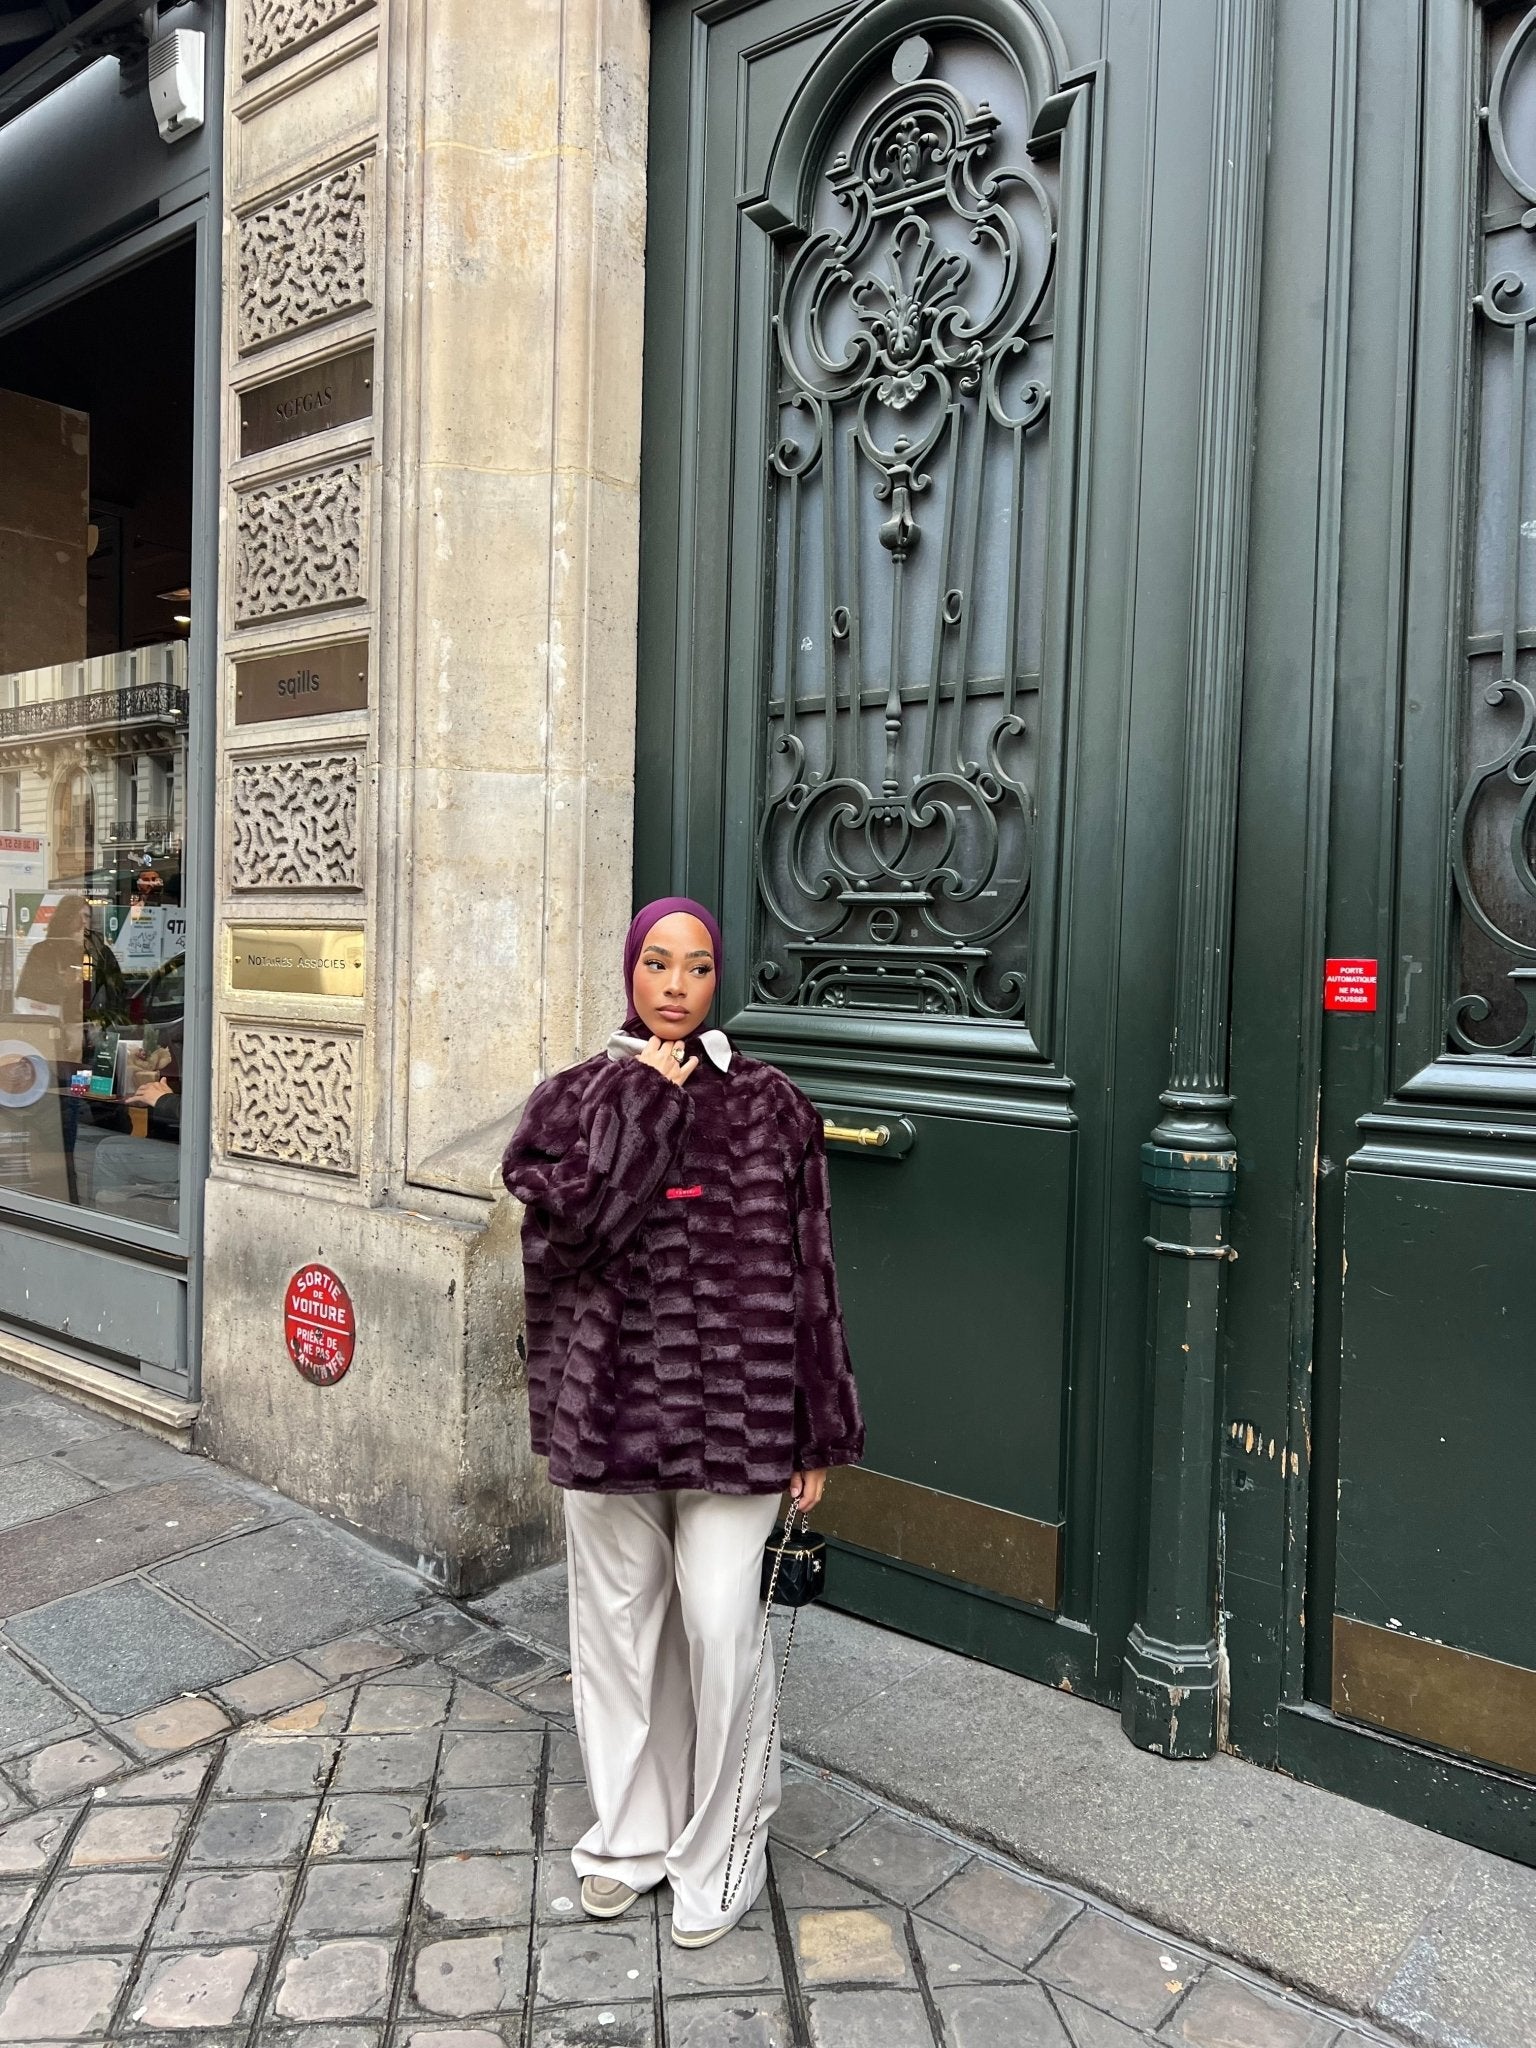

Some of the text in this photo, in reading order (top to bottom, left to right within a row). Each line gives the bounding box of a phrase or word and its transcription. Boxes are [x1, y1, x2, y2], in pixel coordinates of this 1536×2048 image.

[278, 669, 320, 700] sqills
[1340, 967, 1364, 975] PORTE
[1326, 976, 1377, 984] AUTOMATIQUE
[1349, 987, 1364, 995] PAS
[1334, 996, 1368, 1004] POUSSER
[296, 1271, 341, 1302] SORTIE
[312, 1289, 324, 1300] DE
[291, 1295, 346, 1325] VOITURE
[326, 1336, 338, 1351] DE
[303, 1342, 330, 1361] NE PAS
